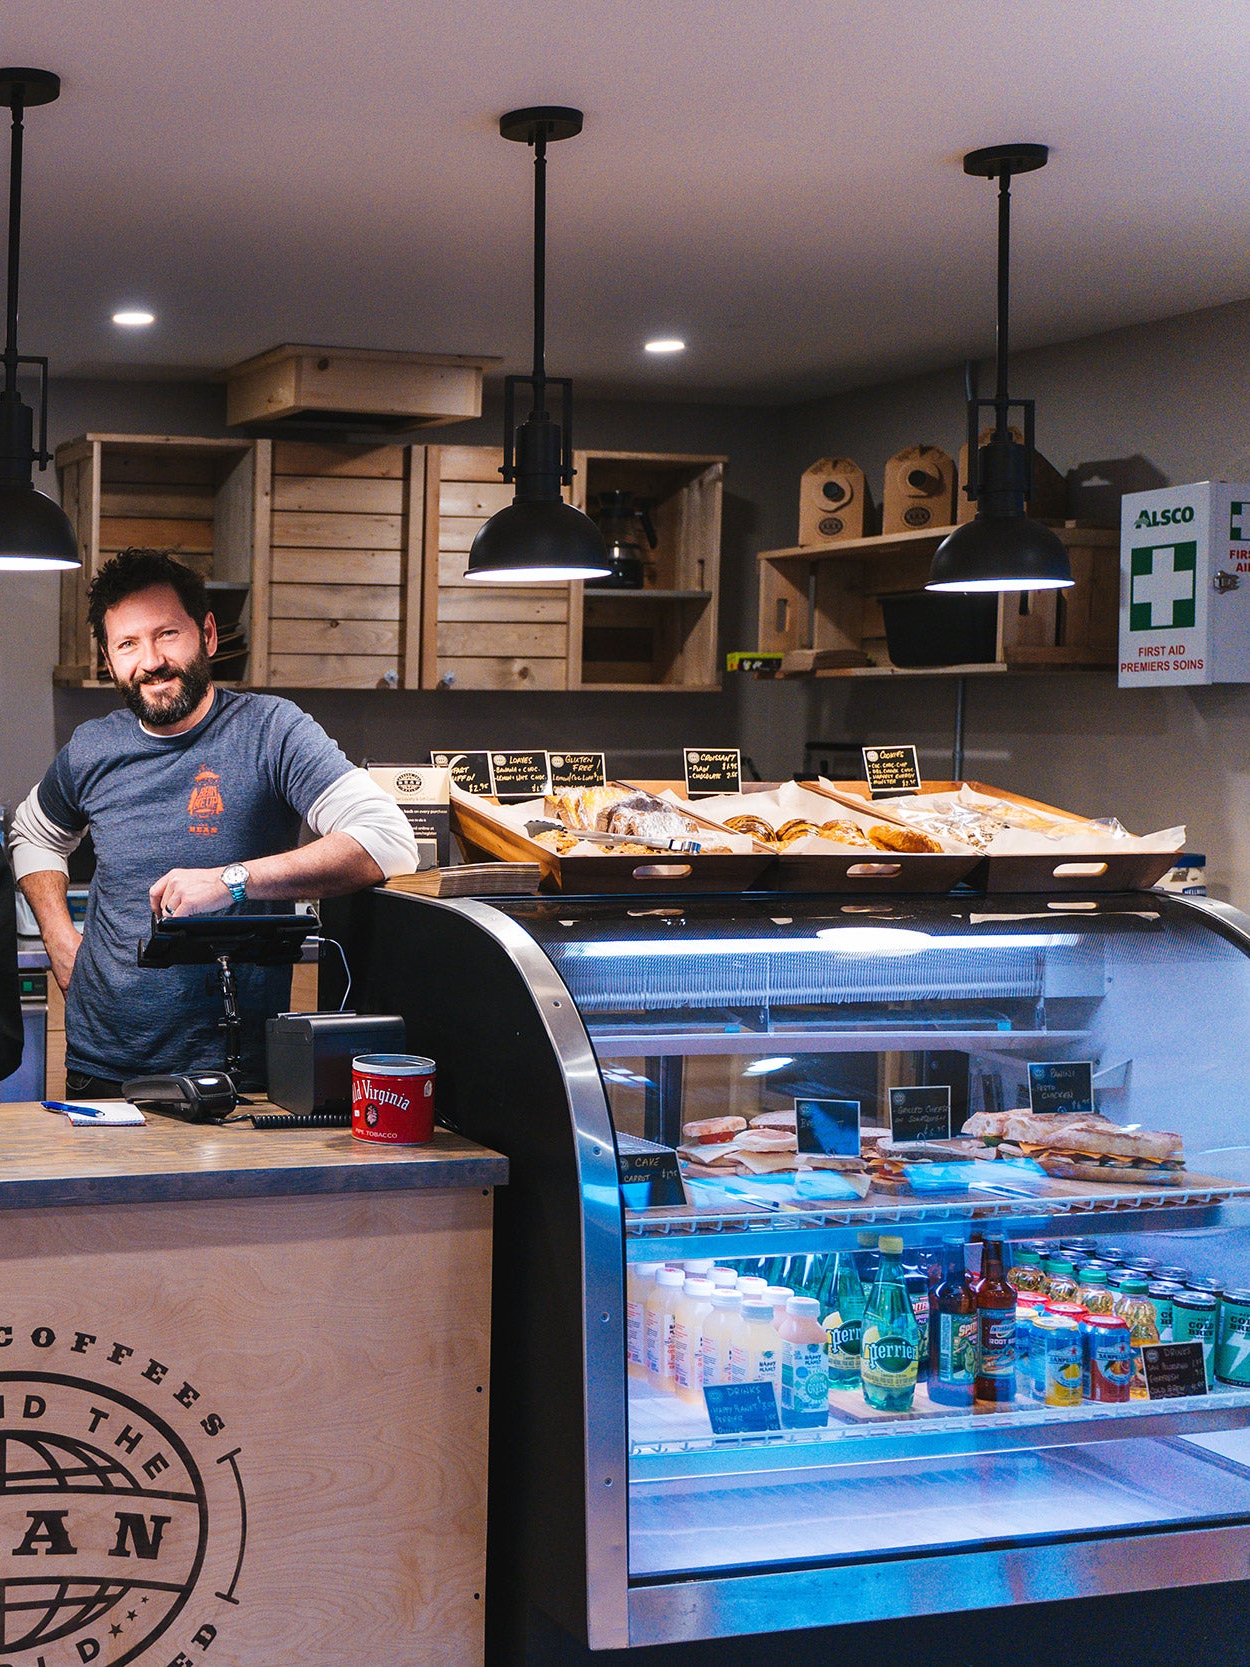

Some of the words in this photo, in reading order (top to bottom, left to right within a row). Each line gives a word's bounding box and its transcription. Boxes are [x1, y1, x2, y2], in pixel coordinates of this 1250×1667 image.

[1134, 506, 1195, 529] ALSCO
[1230, 550, 1250, 560] FIR
[1138, 646, 1166, 657] FIRST
[1168, 644, 1186, 656] AID
[1120, 660, 1170, 673] PREMIERS
[1173, 659, 1204, 670] SOINS
[565, 755, 594, 764] GLUTEN
[362, 1080, 411, 1111] Virginia
[366, 1130, 398, 1139] TOBACCO
[1188, 1321, 1214, 1330] COLD
[1188, 1329, 1213, 1337] BREW
[87, 1407, 171, 1481] THE
